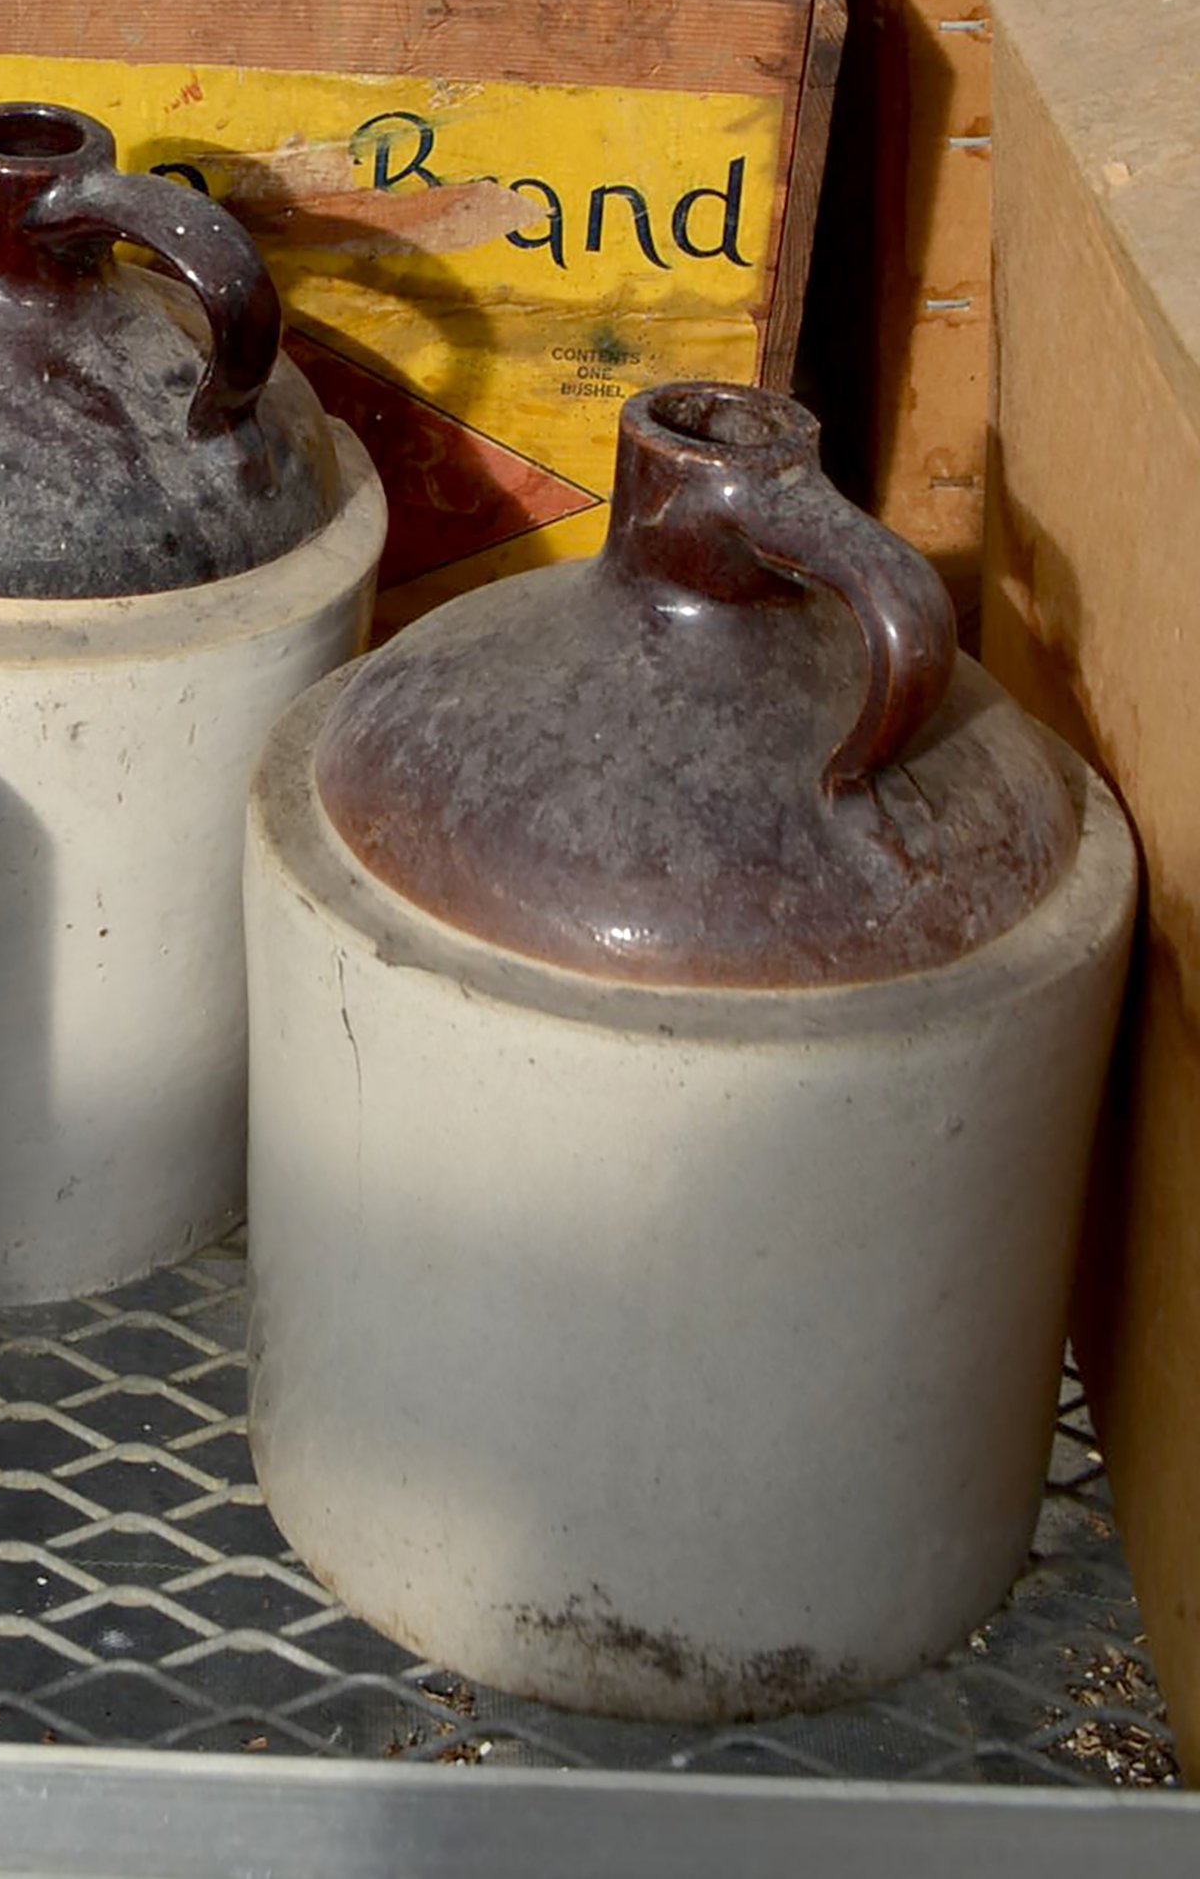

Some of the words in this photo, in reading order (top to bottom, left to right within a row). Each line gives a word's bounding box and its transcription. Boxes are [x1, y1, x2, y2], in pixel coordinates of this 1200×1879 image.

[550, 346, 641, 365] CONTENTS
[576, 365, 614, 381] ONE
[560, 382, 626, 399] BUSHEL
